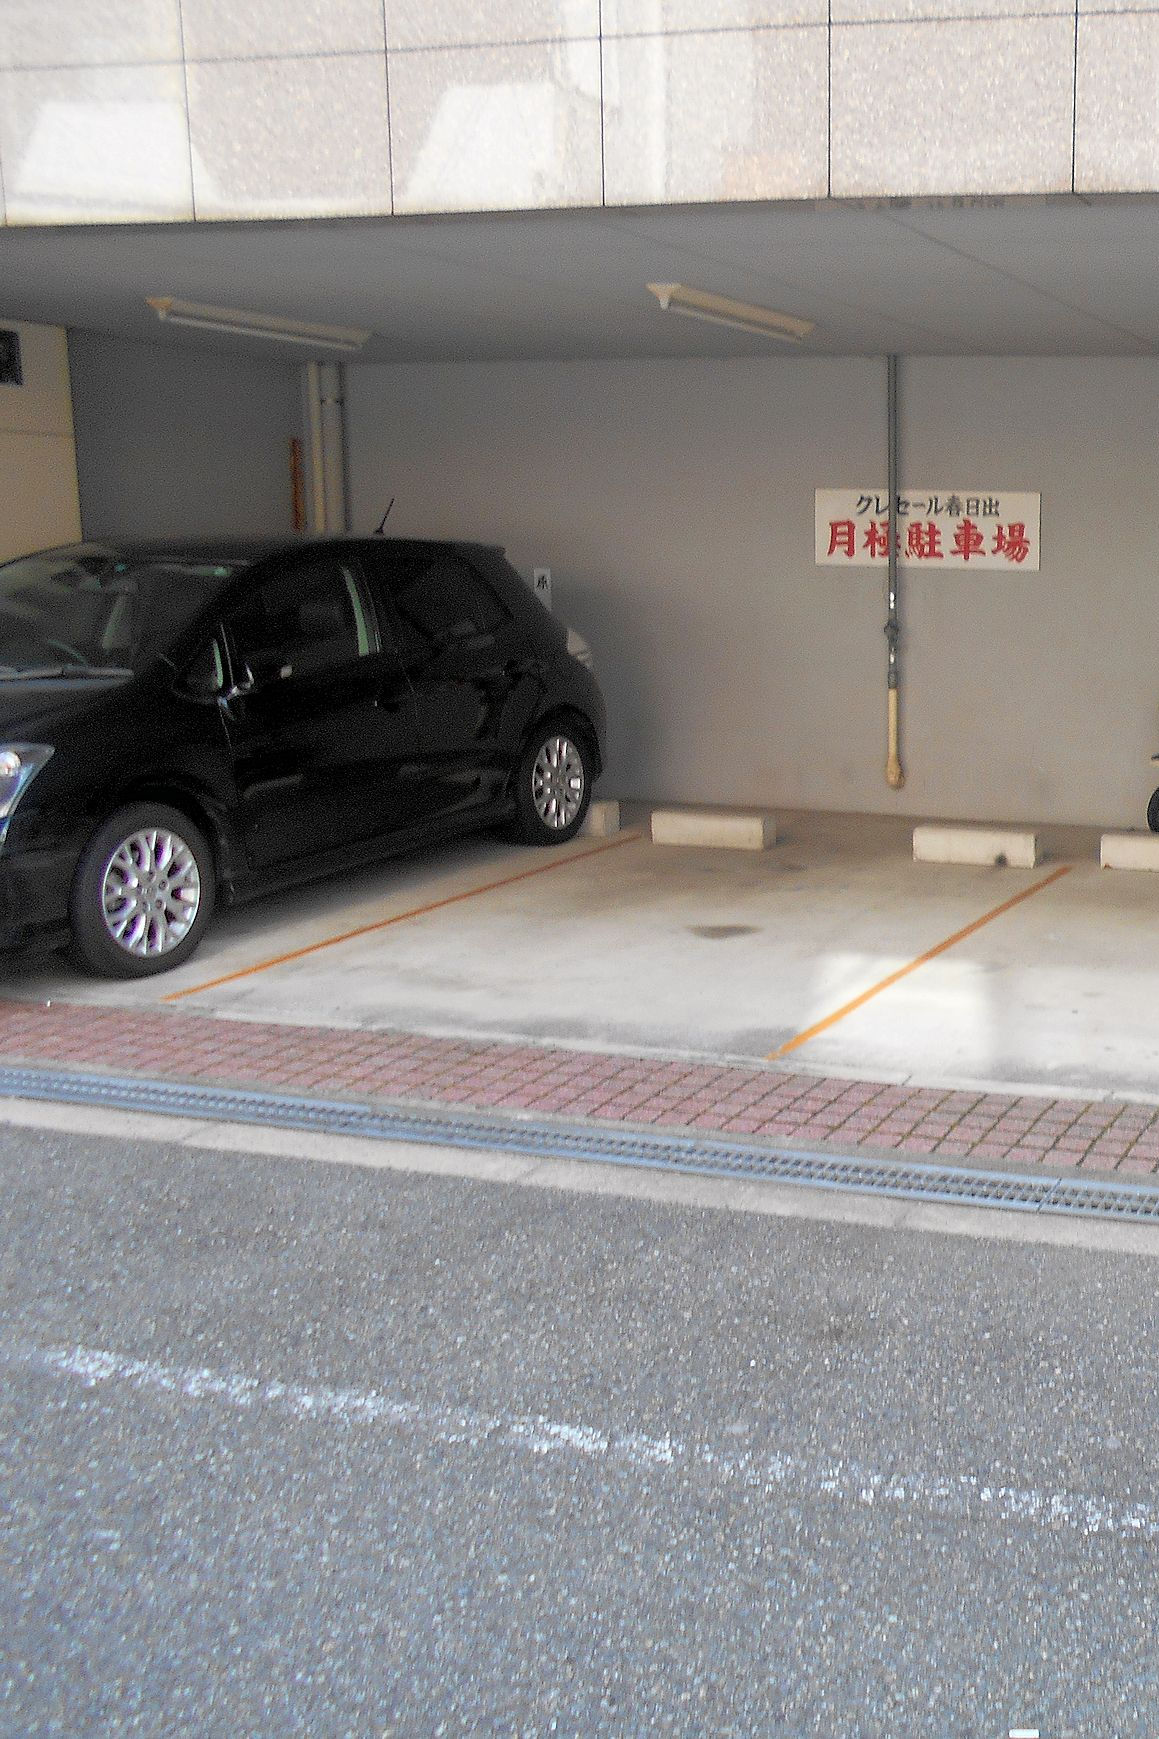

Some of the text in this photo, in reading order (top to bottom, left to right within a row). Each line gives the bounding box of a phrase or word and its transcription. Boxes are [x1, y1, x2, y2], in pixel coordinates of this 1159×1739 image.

[856, 495, 1000, 517] クレセール春日出
[827, 518, 1031, 563] 月極駐車場
